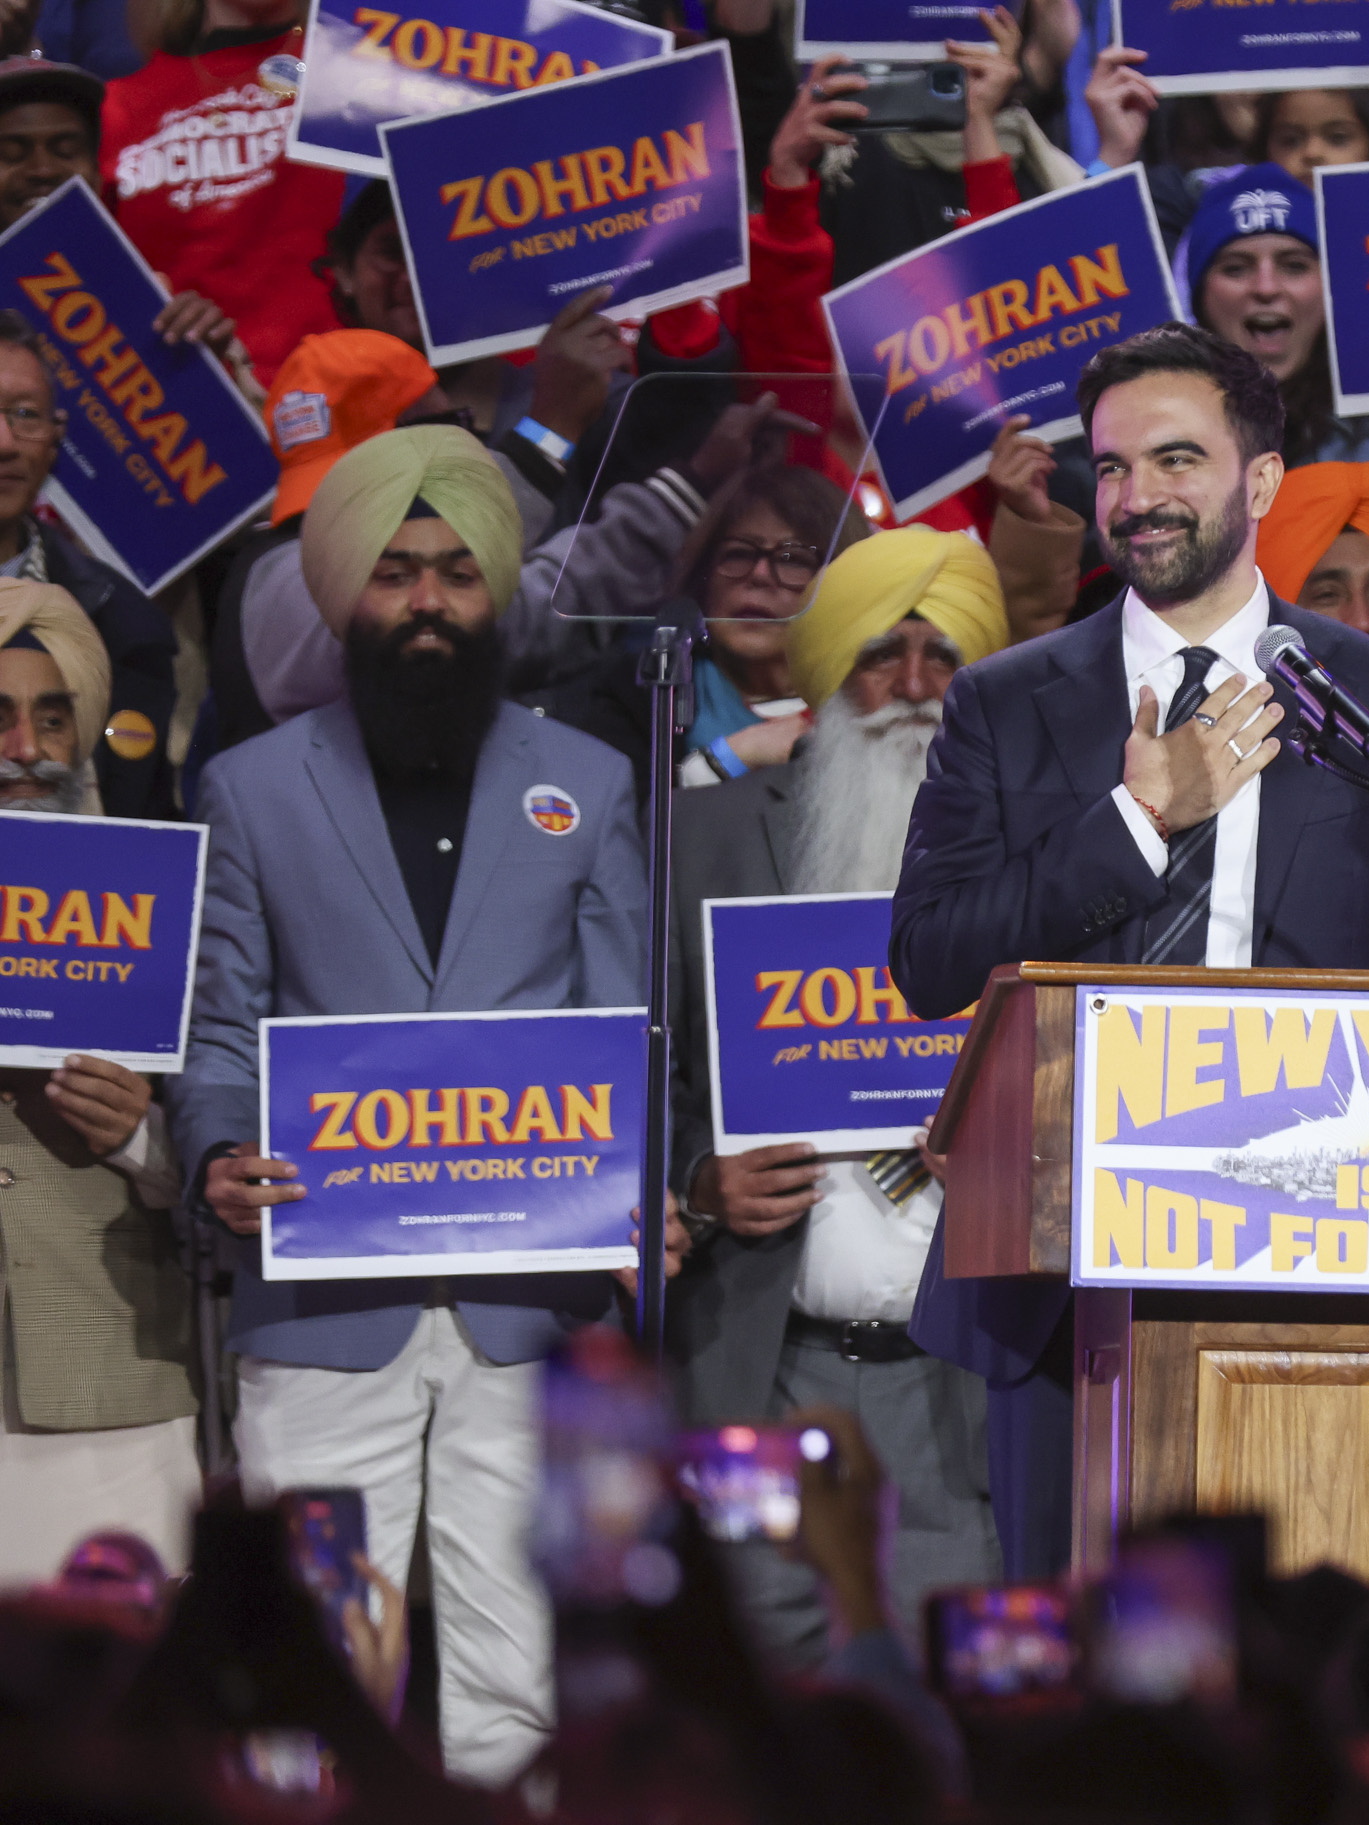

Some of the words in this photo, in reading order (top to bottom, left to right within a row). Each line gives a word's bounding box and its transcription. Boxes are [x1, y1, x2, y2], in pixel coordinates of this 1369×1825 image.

[353, 6, 603, 91] ZOHRA
[439, 121, 711, 242] ZOHRAN
[510, 226, 578, 260] NEW
[581, 207, 650, 243] YORK
[651, 193, 704, 225] CITY
[1235, 207, 1290, 233] UFT
[872, 242, 1131, 397] ZOHRAN
[15, 251, 229, 505] ZOHRAN
[929, 361, 983, 405] NEW
[985, 333, 1057, 374] YORK
[1058, 311, 1123, 348] CITY
[76, 387, 133, 455] YORK
[124, 452, 176, 508] CITY
[0, 885, 157, 951] RAN
[0, 956, 60, 980] ORK
[65, 959, 135, 984] CITY
[818, 1036, 889, 1061] NEW
[1096, 1002, 1338, 1144] NEW
[306, 1083, 615, 1151] ZOHRAN
[369, 1161, 440, 1185] NEW
[445, 1157, 527, 1182] YORK
[531, 1155, 601, 1179] CITY
[398, 1211, 527, 1226] ZOHRANFORNYC.COM
[1092, 1166, 1247, 1272] NOT
